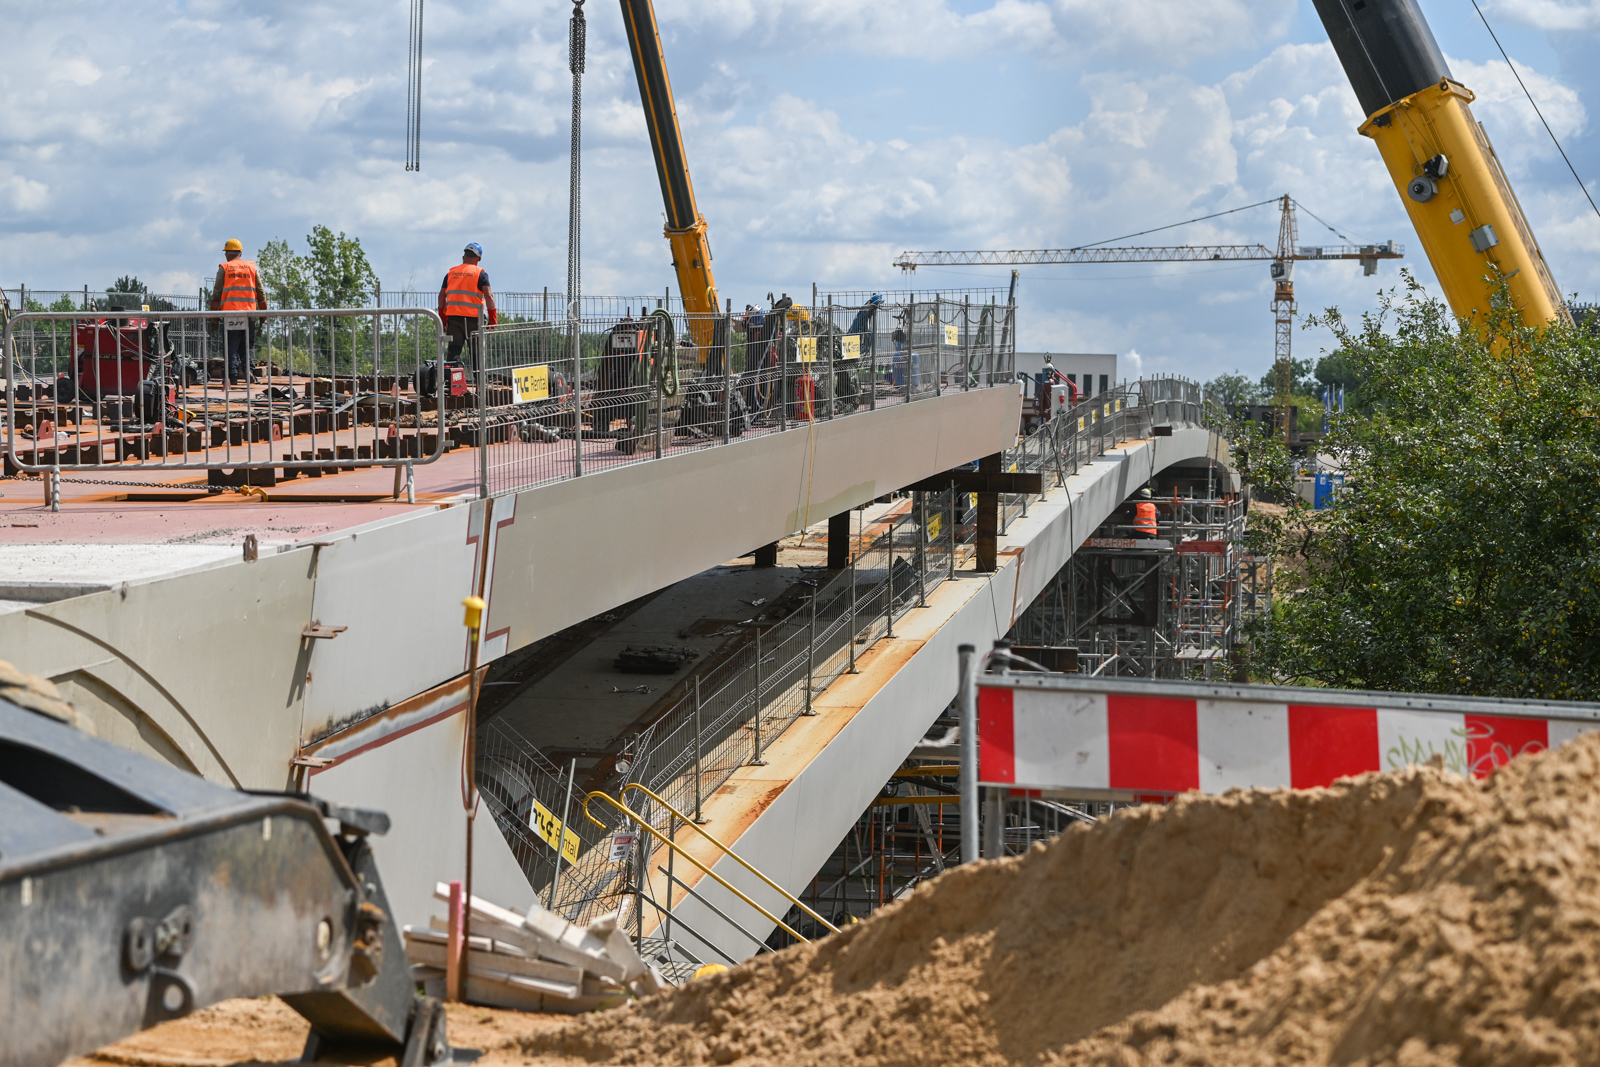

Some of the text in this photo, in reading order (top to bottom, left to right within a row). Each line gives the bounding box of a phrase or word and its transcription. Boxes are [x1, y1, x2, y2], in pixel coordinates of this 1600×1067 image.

[514, 373, 548, 394] TLC Rental
[1092, 538, 1137, 548] SCAFORM
[533, 807, 577, 859] TLC Rntal
